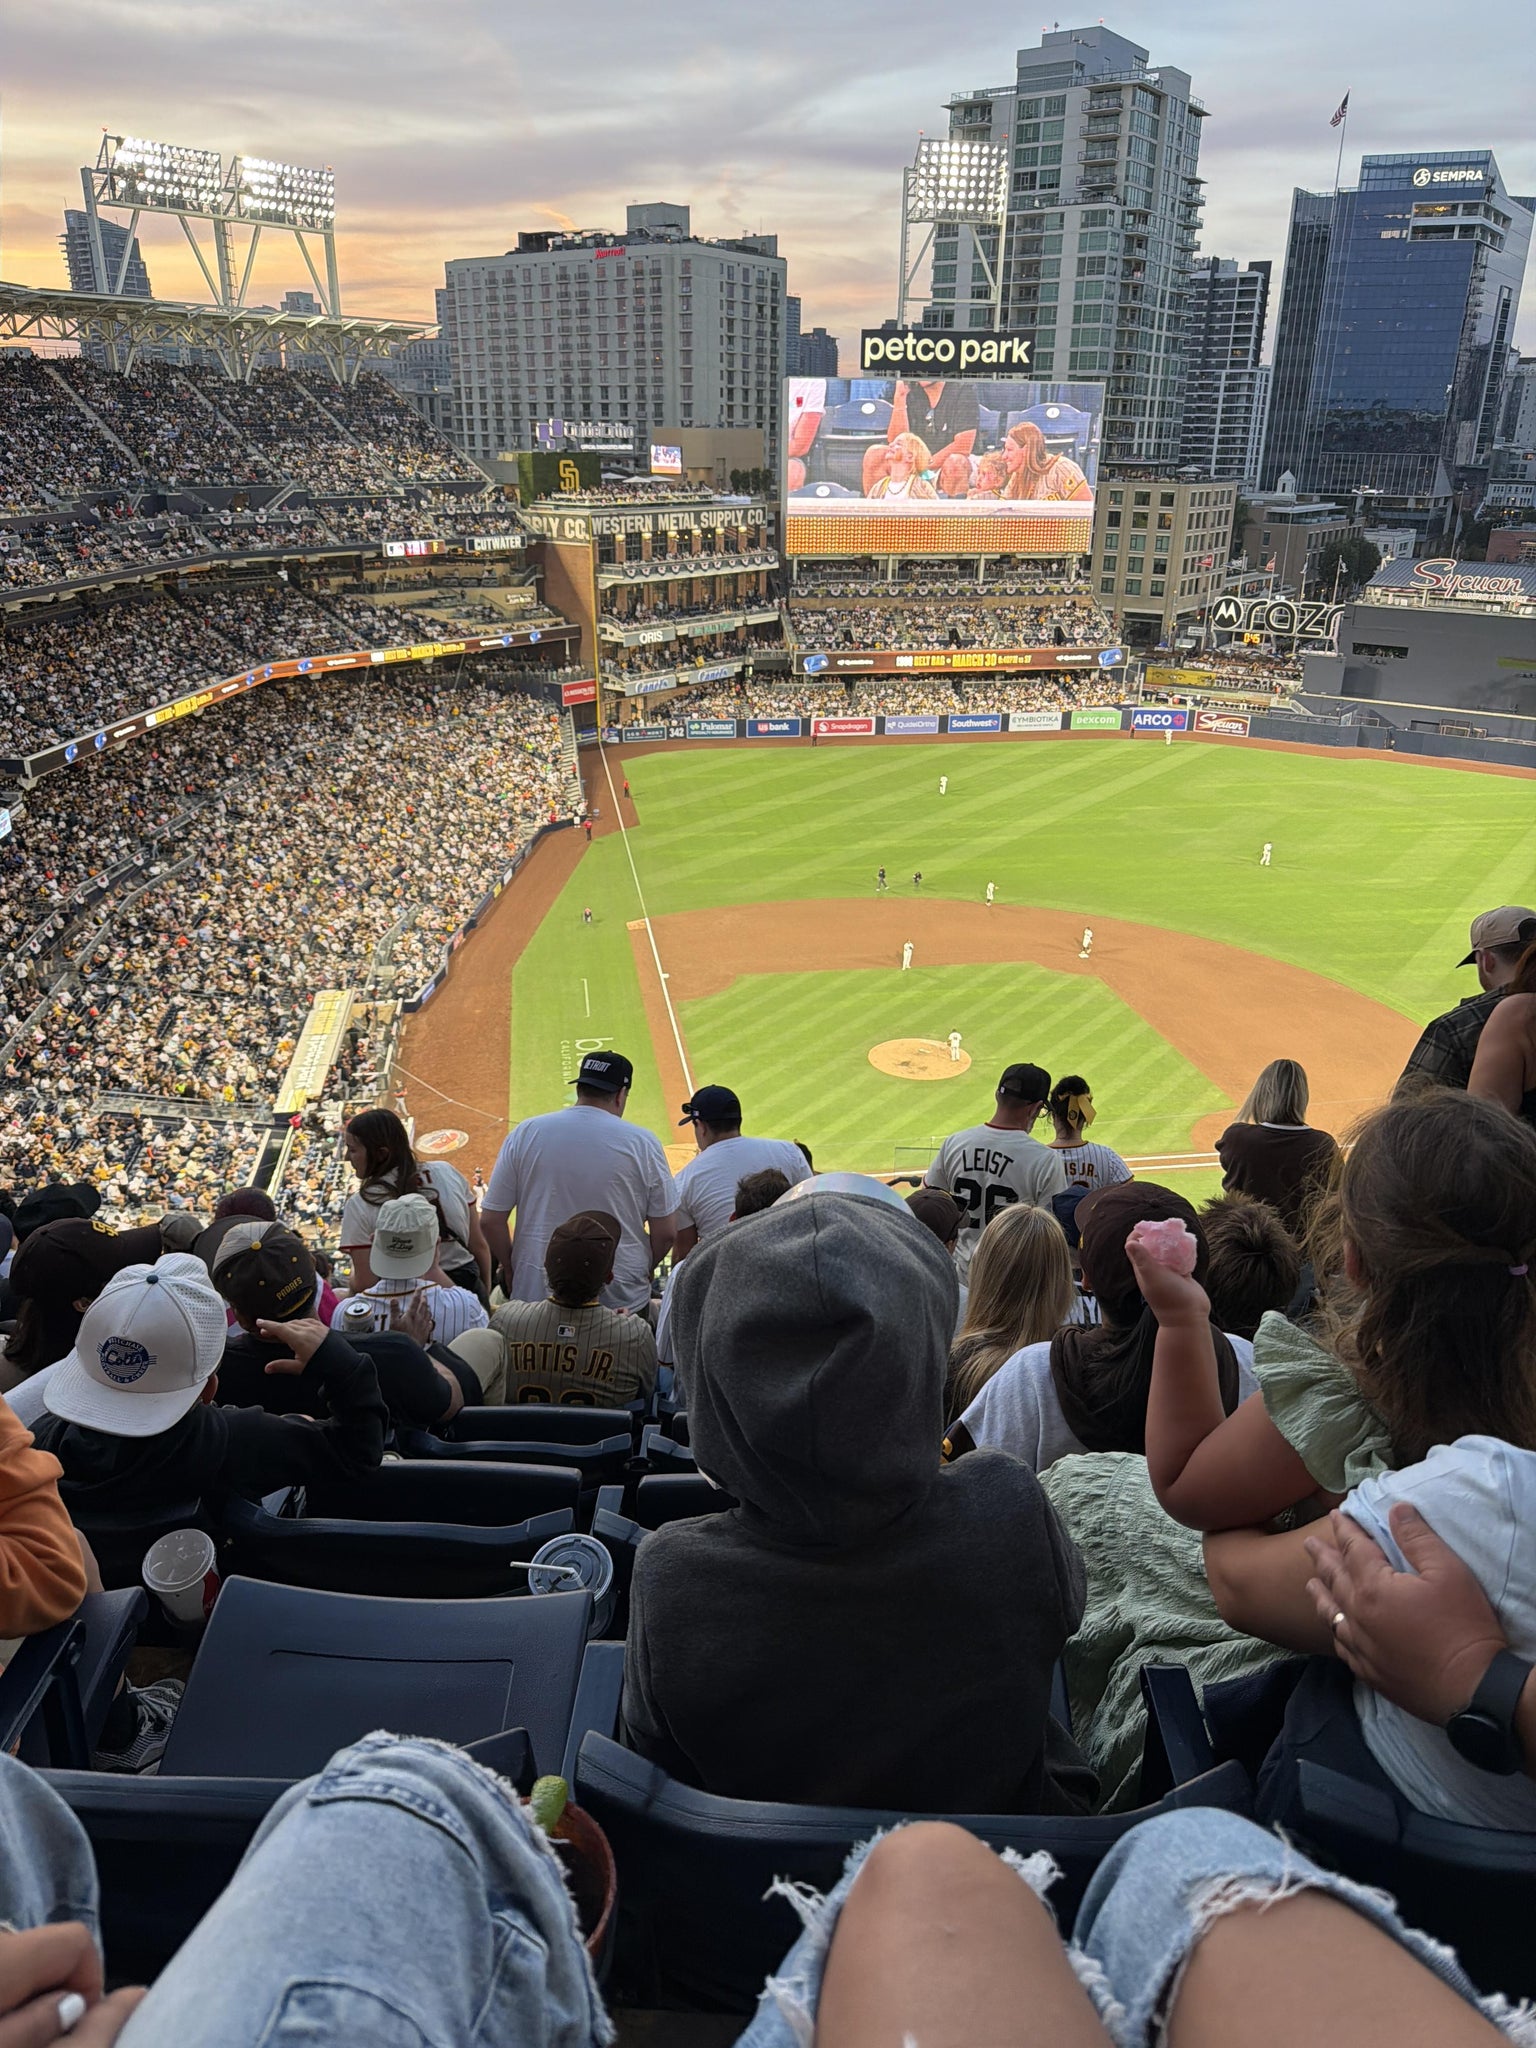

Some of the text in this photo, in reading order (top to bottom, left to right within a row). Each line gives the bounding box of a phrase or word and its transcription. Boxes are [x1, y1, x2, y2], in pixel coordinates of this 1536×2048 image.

[1432, 170, 1483, 182] SEMPRA
[864, 332, 1031, 369] petco park
[591, 509, 766, 535] WESTERN METAL SUPPLY CO.
[474, 535, 521, 550] CUTWATER
[1410, 558, 1525, 598] Sycuan
[1246, 599, 1346, 638] razr
[639, 630, 664, 645] ORIS
[952, 653, 984, 668] MARCH
[984, 653, 997, 667] 30
[700, 722, 733, 731] Palomar
[769, 722, 790, 731] bank
[830, 722, 868, 731] Snapdragon
[952, 719, 991, 729] Southwest
[1134, 715, 1172, 726] ARCO
[1199, 714, 1243, 731] Sycuan
[669, 727, 684, 738] 342
[560, 1040, 572, 1085] CALIFORNIA
[583, 1059, 611, 1073] DETROIT
[962, 1148, 1015, 1178] LEIST
[1079, 1162, 1098, 1178] JR.
[276, 1276, 303, 1300] PADRES
[510, 1342, 615, 1383] TATIS JR.
